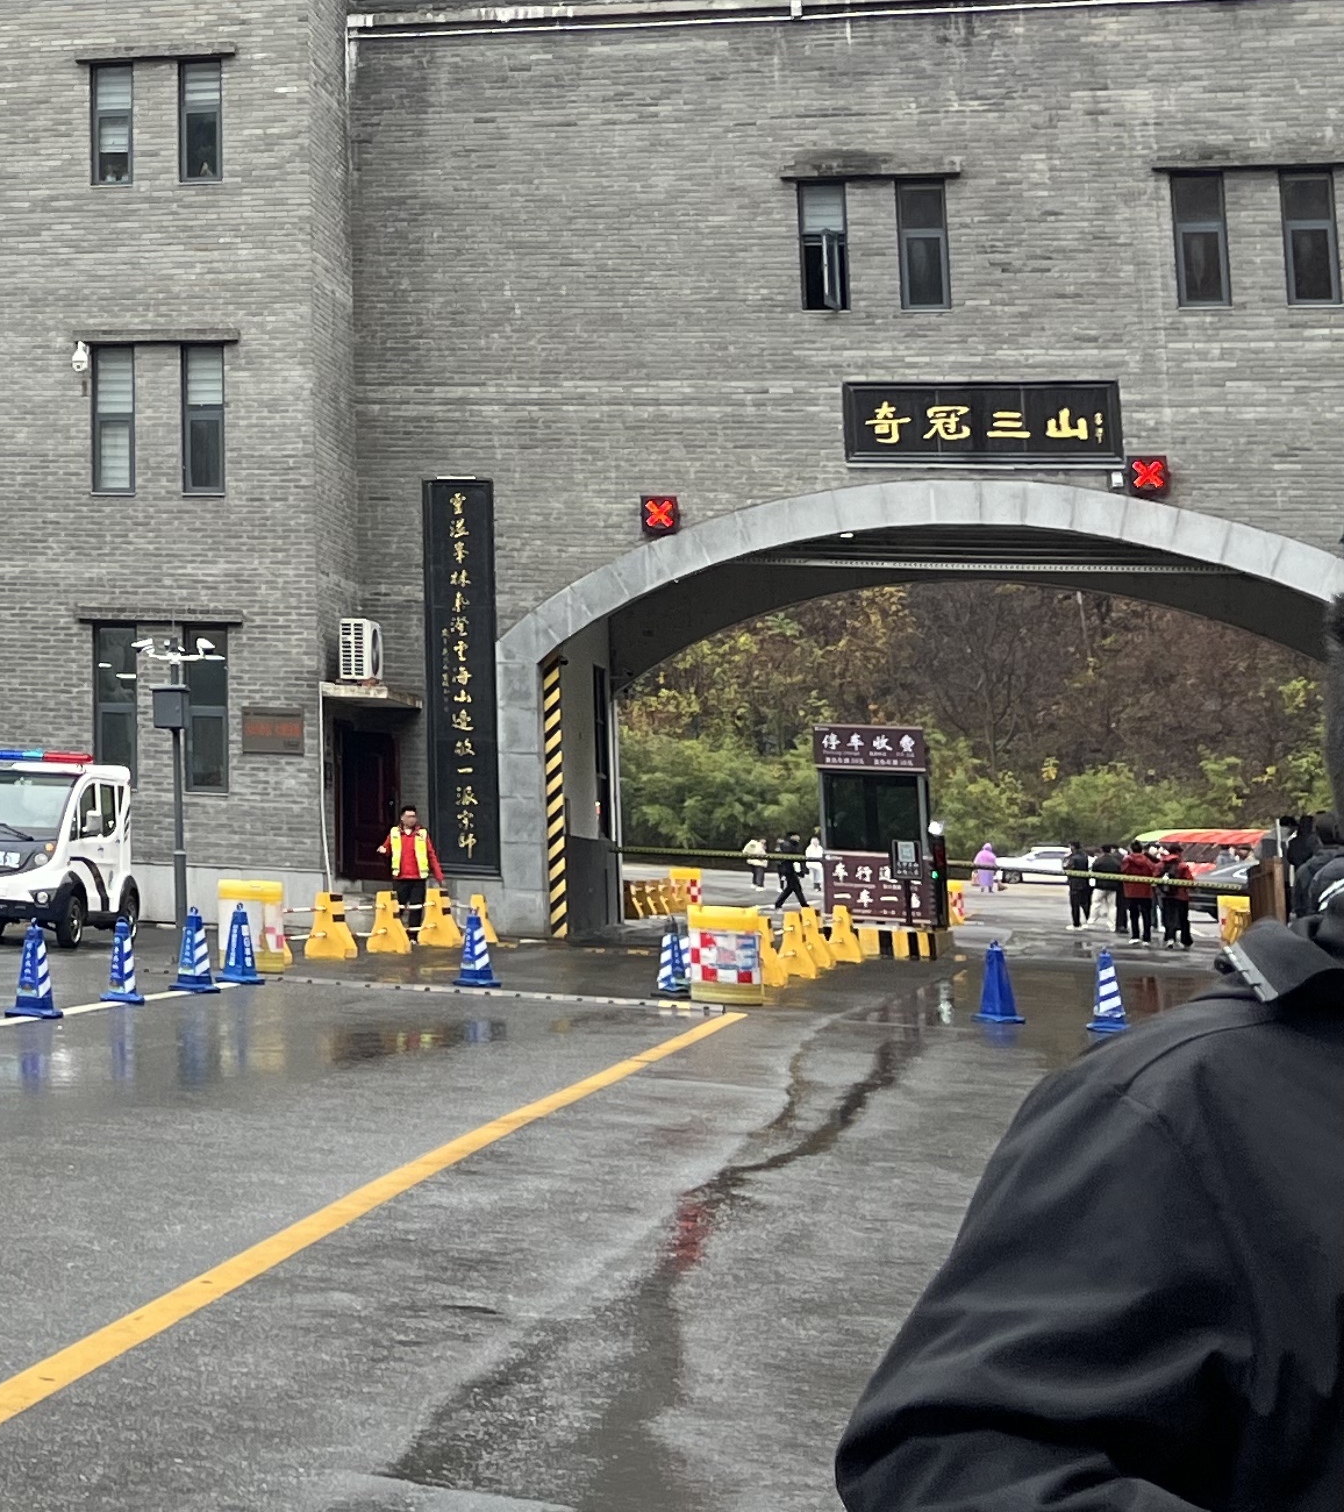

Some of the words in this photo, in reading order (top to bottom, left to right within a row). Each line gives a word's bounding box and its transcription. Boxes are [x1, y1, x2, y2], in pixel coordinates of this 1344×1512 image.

[864, 400, 1089, 444] 奇冠三山
[822, 732, 916, 753] 停车收费
